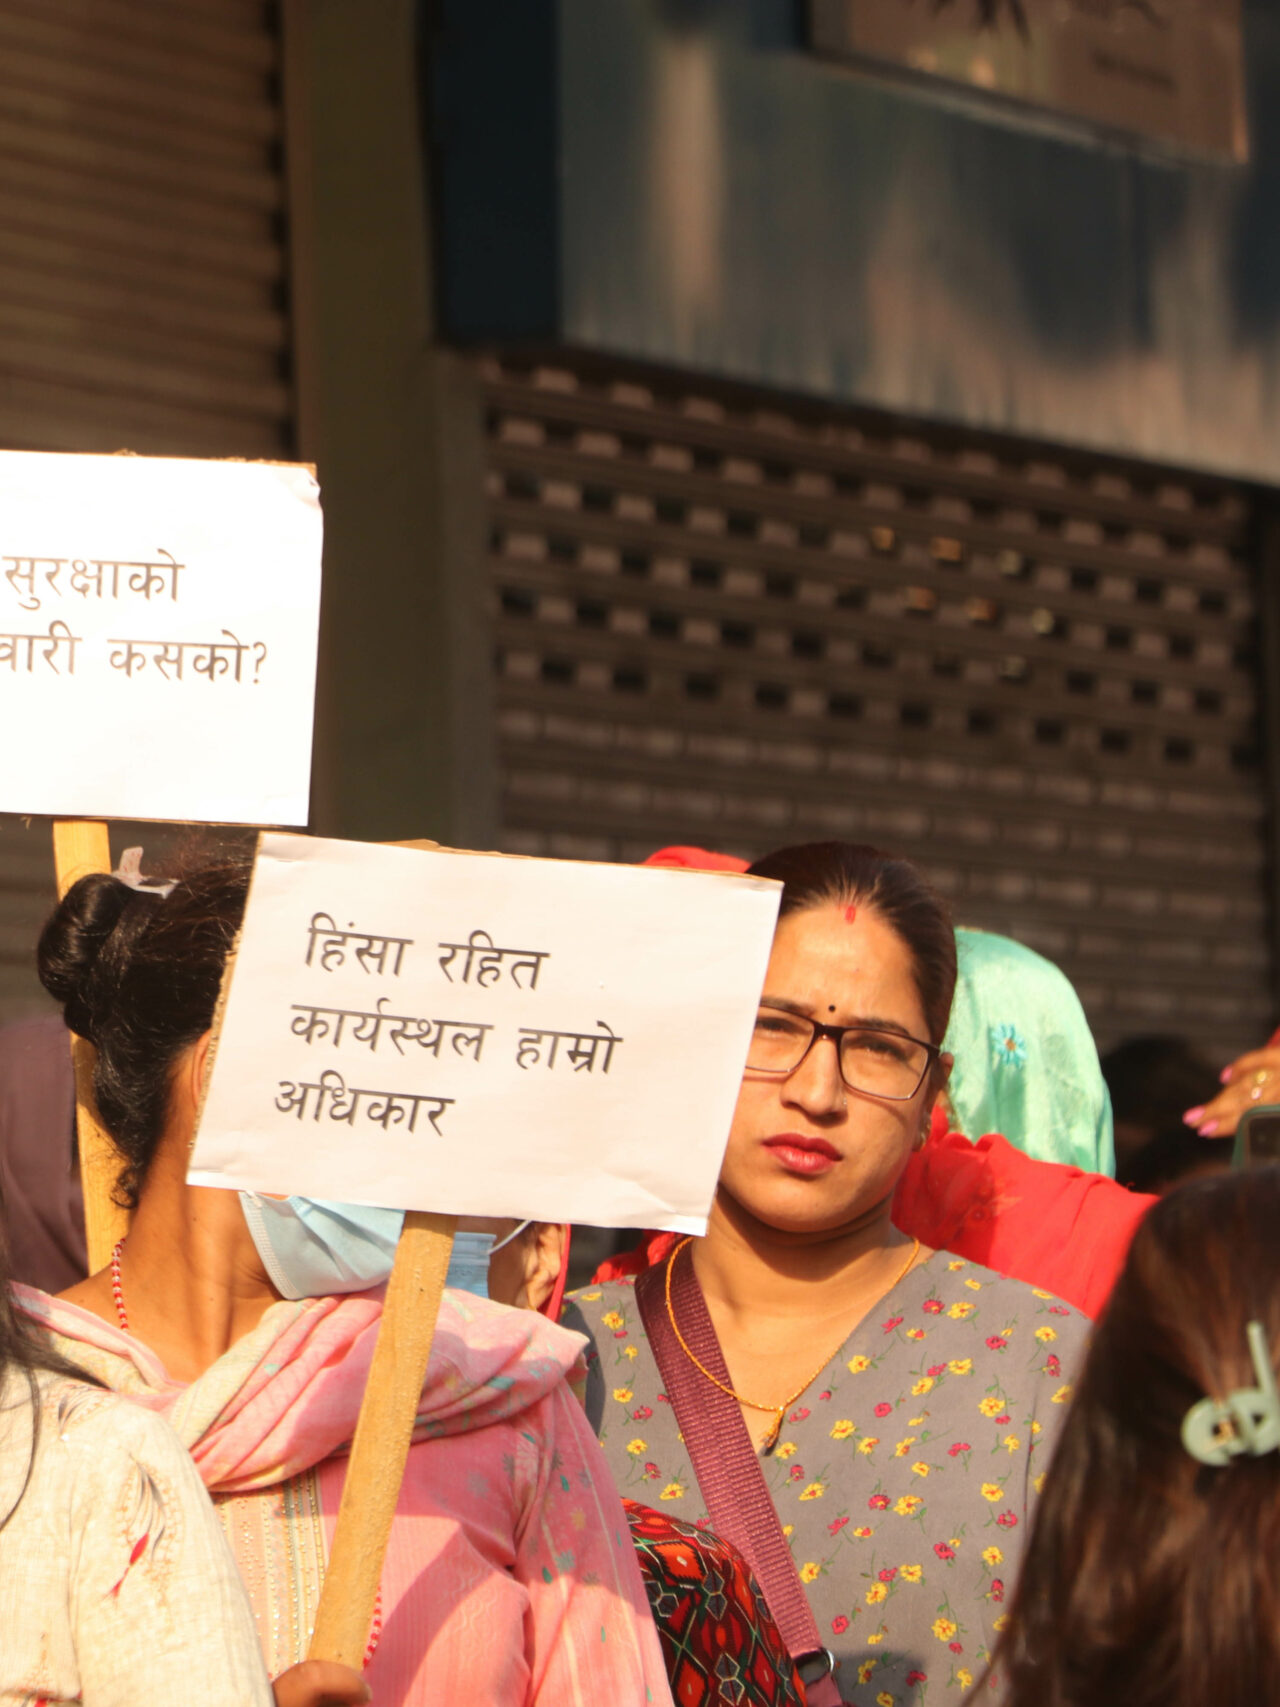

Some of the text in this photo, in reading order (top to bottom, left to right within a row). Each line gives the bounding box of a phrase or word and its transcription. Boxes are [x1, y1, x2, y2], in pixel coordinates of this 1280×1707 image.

[2, 548, 186, 610] सुरक्षाको
[107, 629, 268, 684] कसको?
[306, 912, 550, 990] हिंसा रहित
[291, 998, 624, 1074] कार्यस्थल हाम्रो
[275, 1070, 455, 1136] अधिकार
